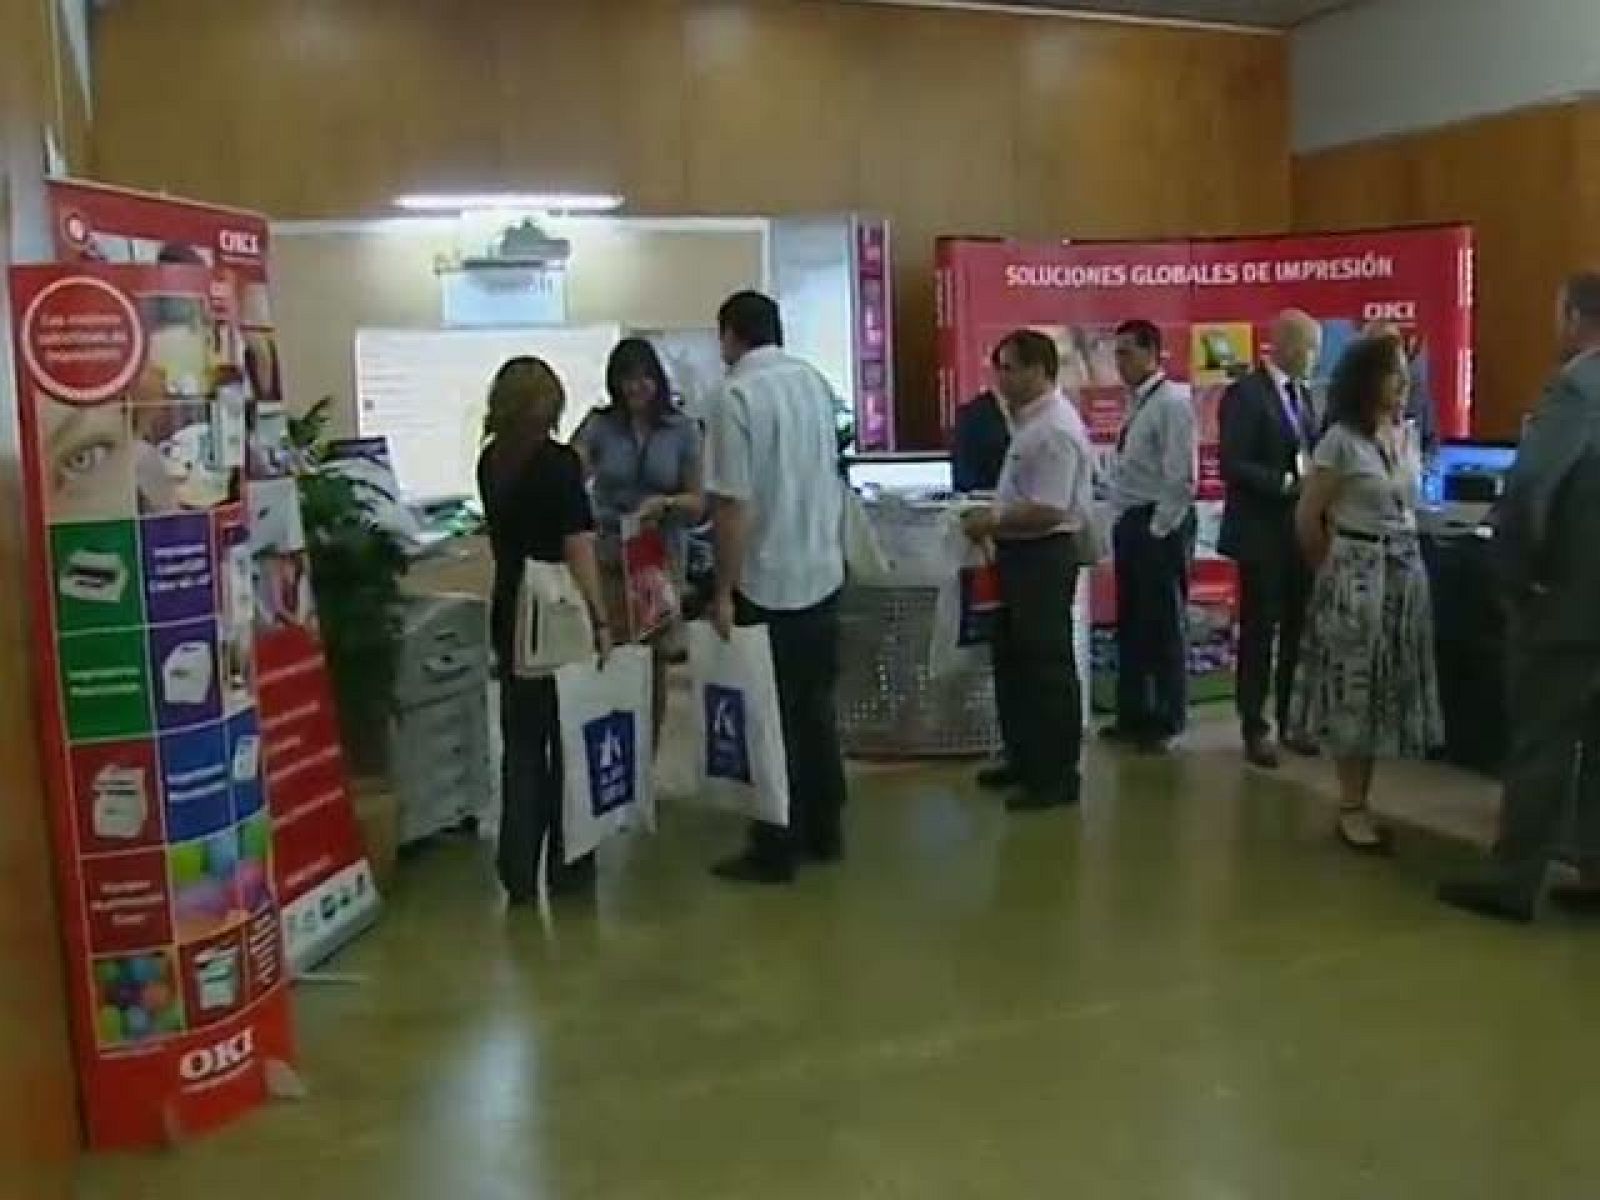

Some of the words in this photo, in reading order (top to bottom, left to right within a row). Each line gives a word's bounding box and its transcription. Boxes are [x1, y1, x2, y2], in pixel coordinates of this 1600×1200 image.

[219, 230, 259, 254] OKI
[1004, 264, 1127, 287] SOLUCIONES
[1131, 262, 1238, 285] GLOBALES
[1242, 262, 1271, 283] DE
[1275, 250, 1393, 281] IMPRESIÓN
[1364, 301, 1415, 319] OKI
[180, 1027, 254, 1079] OKI
